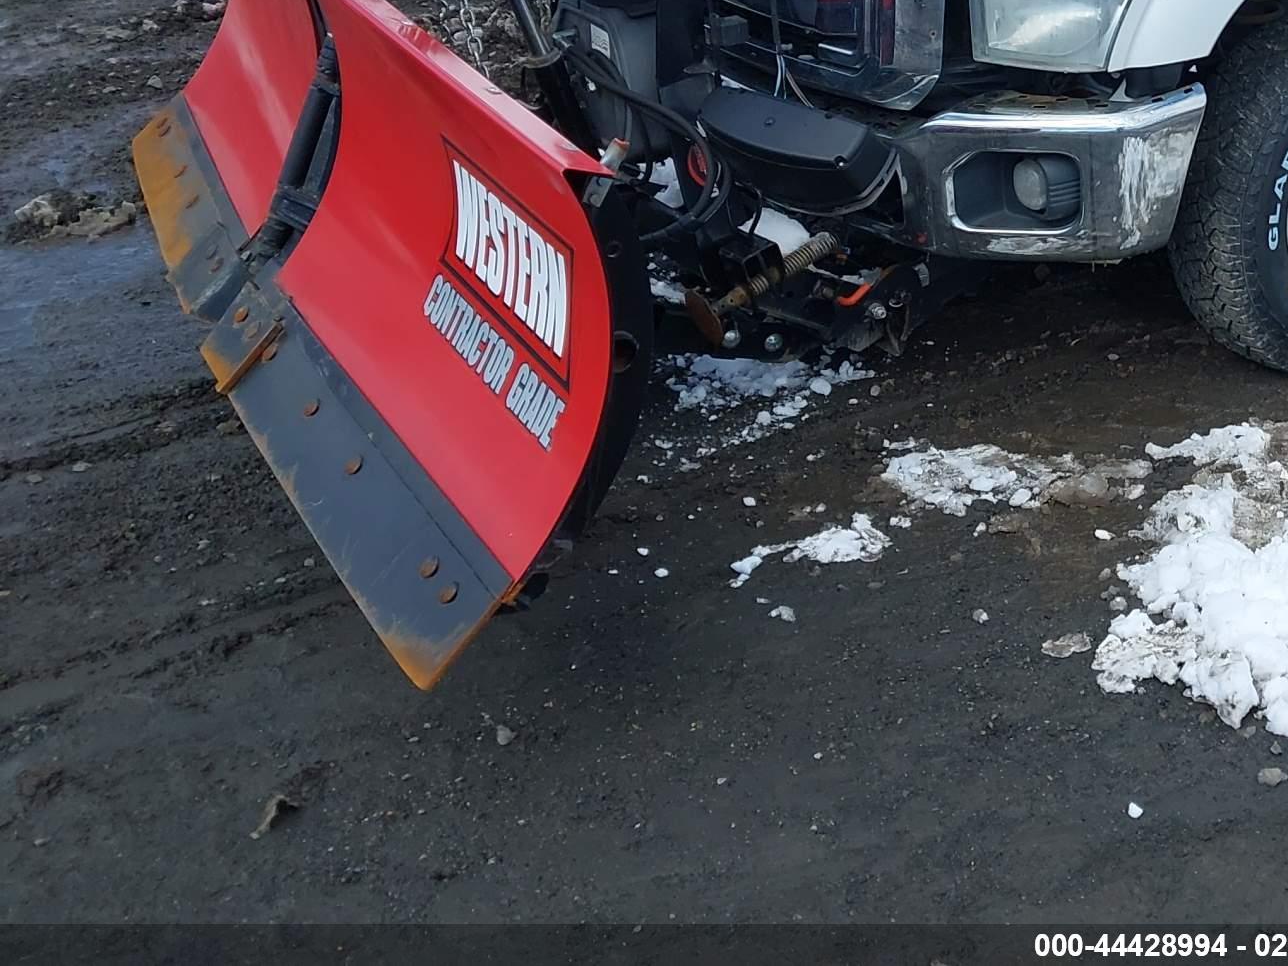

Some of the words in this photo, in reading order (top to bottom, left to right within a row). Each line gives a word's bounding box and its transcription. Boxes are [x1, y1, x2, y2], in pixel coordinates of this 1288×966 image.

[452, 159, 567, 359] WESTERN
[422, 273, 515, 395] CONTRACTOR
[504, 361, 567, 450] GRADE
